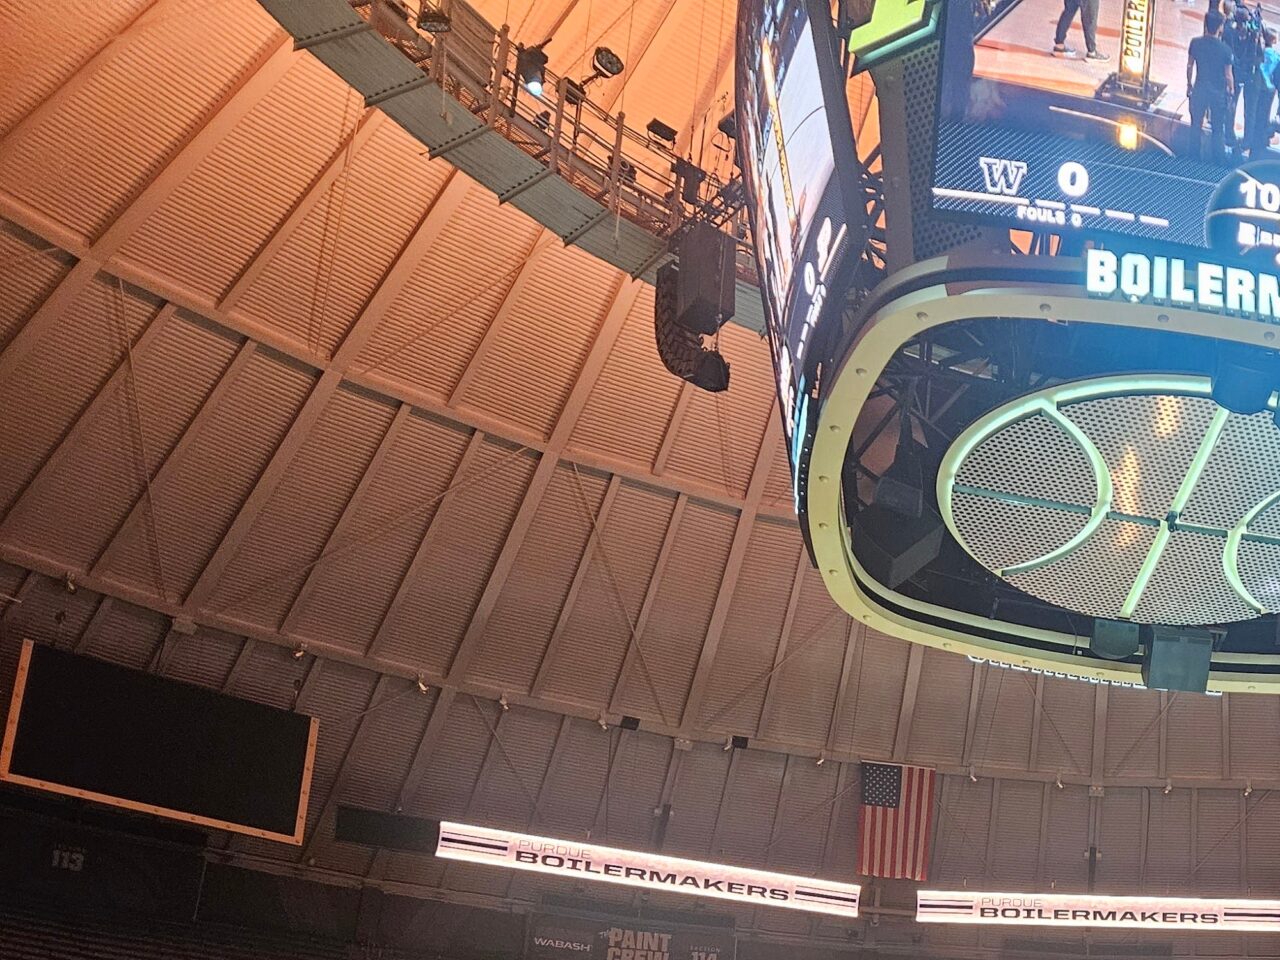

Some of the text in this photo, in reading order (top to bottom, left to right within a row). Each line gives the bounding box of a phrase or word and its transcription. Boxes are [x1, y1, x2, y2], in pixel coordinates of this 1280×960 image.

[980, 156, 1027, 195] W
[1057, 161, 1089, 197] 0
[1017, 206, 1082, 227] FOULS 0
[518, 839, 592, 860] PURDUE
[514, 851, 789, 901] BOILERMAKERS
[981, 897, 1042, 908] PURDUE
[979, 907, 1219, 924] BOILERMAKERS
[534, 936, 592, 952] WABASH
[608, 927, 672, 952] PAINT
